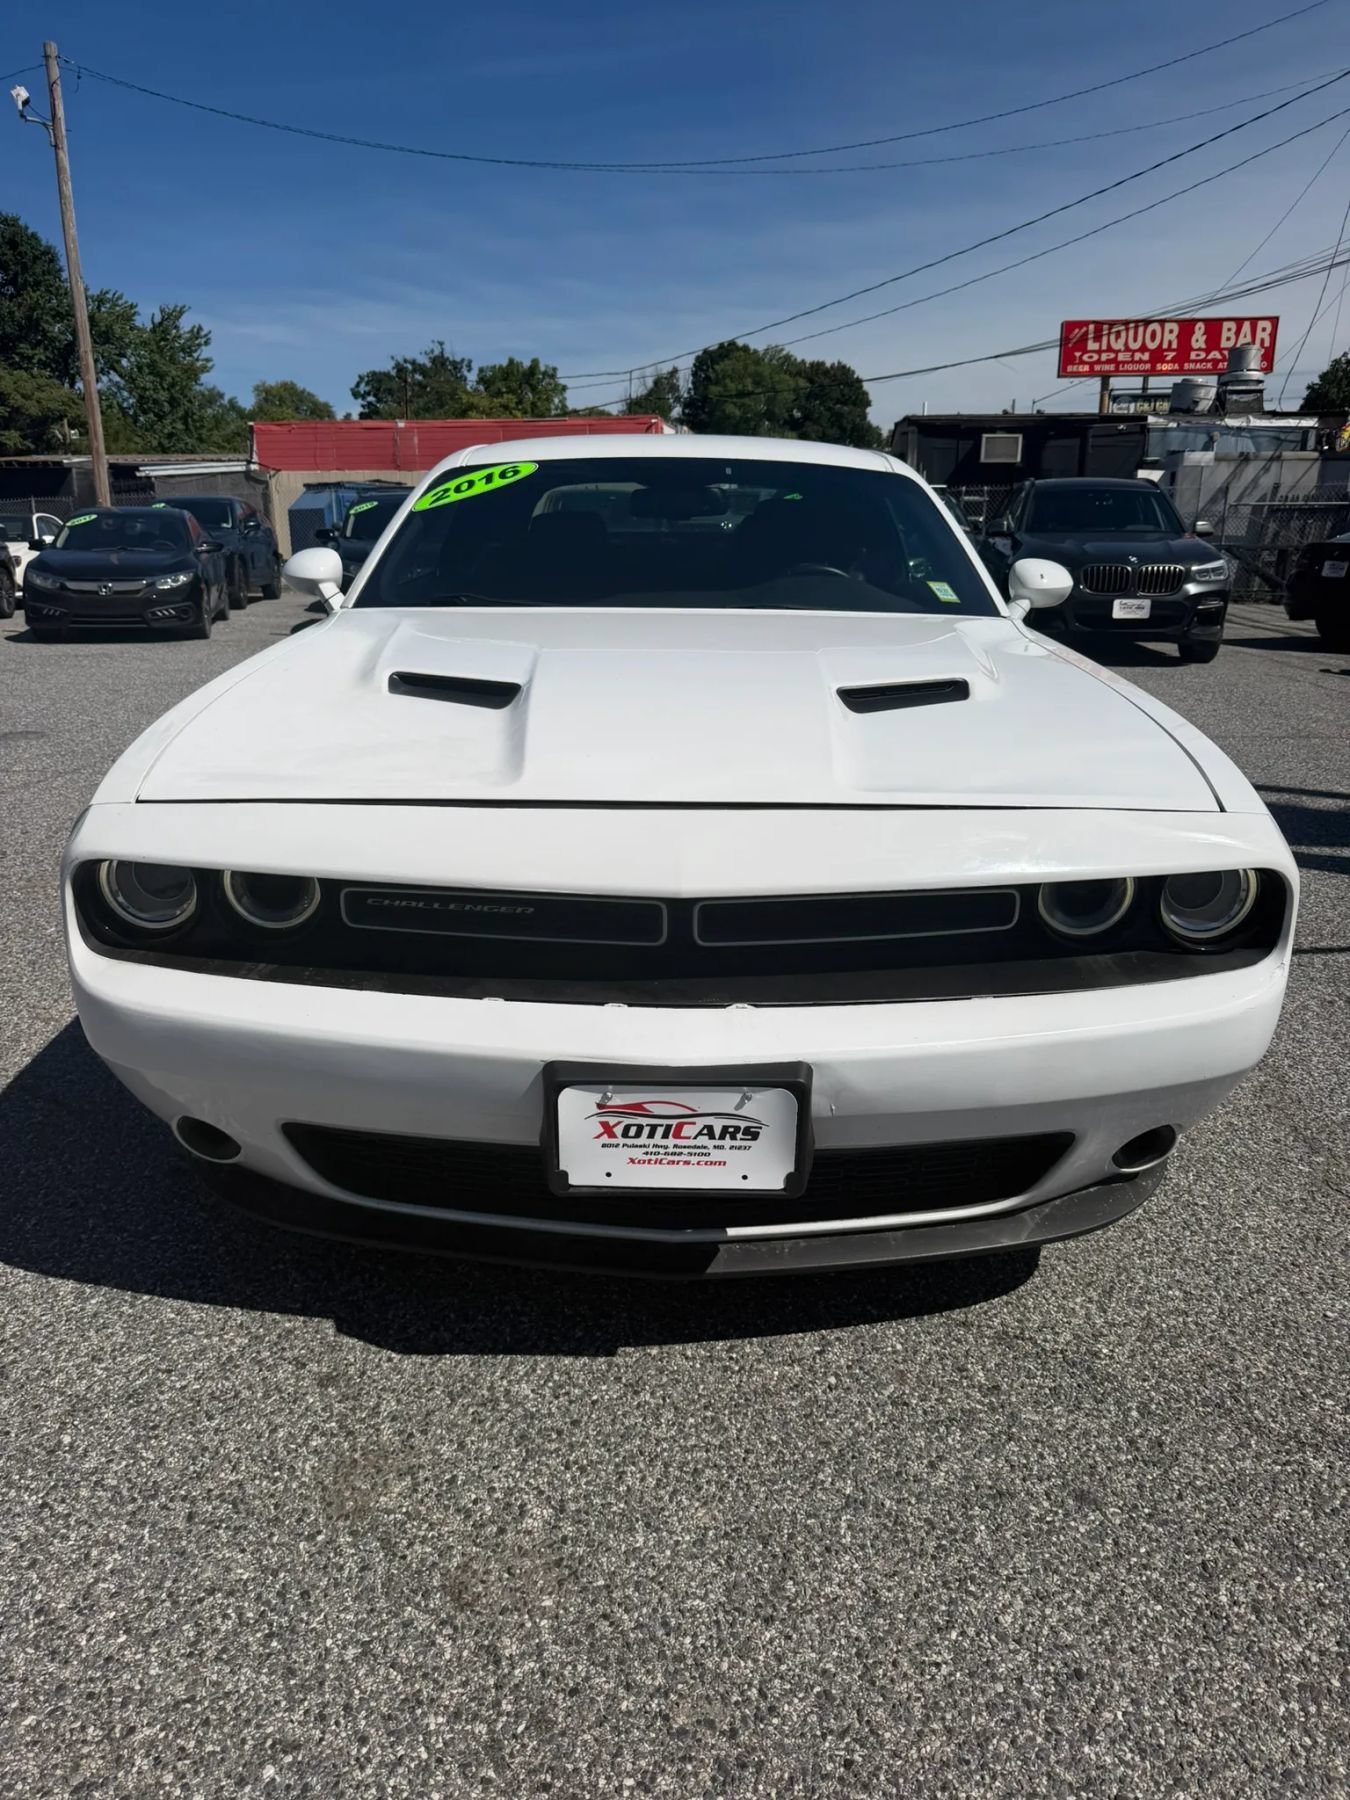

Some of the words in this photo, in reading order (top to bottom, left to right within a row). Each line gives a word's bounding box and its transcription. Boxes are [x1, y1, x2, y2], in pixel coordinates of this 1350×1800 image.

[1087, 322, 1178, 351] LIQUOR
[1191, 321, 1207, 349] &
[1220, 320, 1272, 349] BAR
[1082, 352, 1150, 362] OPEN
[1163, 351, 1177, 361] 7
[1119, 363, 1151, 371] LIQUOR
[1156, 362, 1179, 371] SODA
[1184, 361, 1213, 370] SNACK
[1217, 361, 1228, 369] AT
[428, 465, 521, 506] 2016
[366, 898, 535, 914] CHALLENGER
[652, 1143, 670, 1151] Hwy.
[627, 1158, 727, 1167] XotiCars.com
